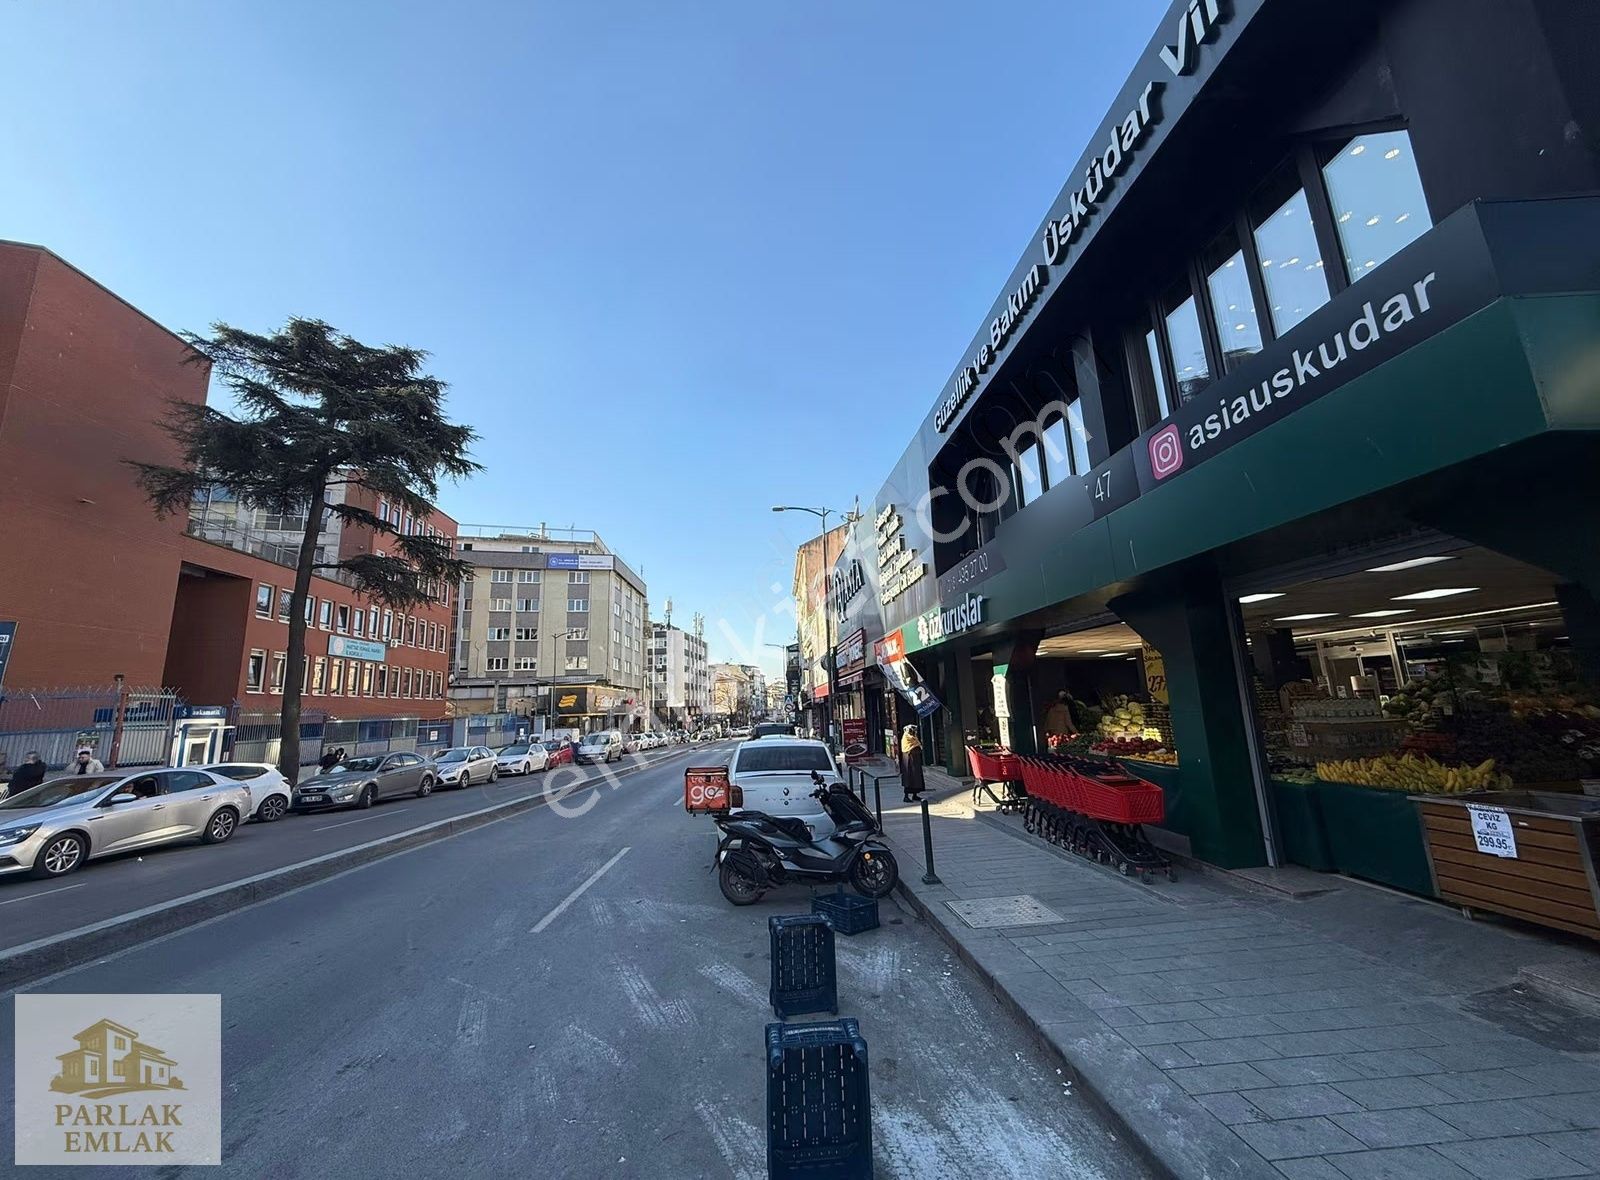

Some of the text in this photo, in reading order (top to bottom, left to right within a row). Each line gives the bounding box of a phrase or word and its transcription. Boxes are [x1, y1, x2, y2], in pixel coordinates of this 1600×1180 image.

[933, 366, 974, 434] Güzellik
[972, 343, 990, 372] ve
[989, 266, 1040, 349] Bakım
[1042, 80, 1154, 266] Üsküdar
[1188, 271, 1437, 450] asiauskudar
[929, 593, 984, 640] özkuruşlar
[909, 686, 930, 707] 22
[1477, 812, 1501, 822] CEVİZ
[1485, 822, 1498, 830] KG
[1477, 835, 1508, 850] 299.95
